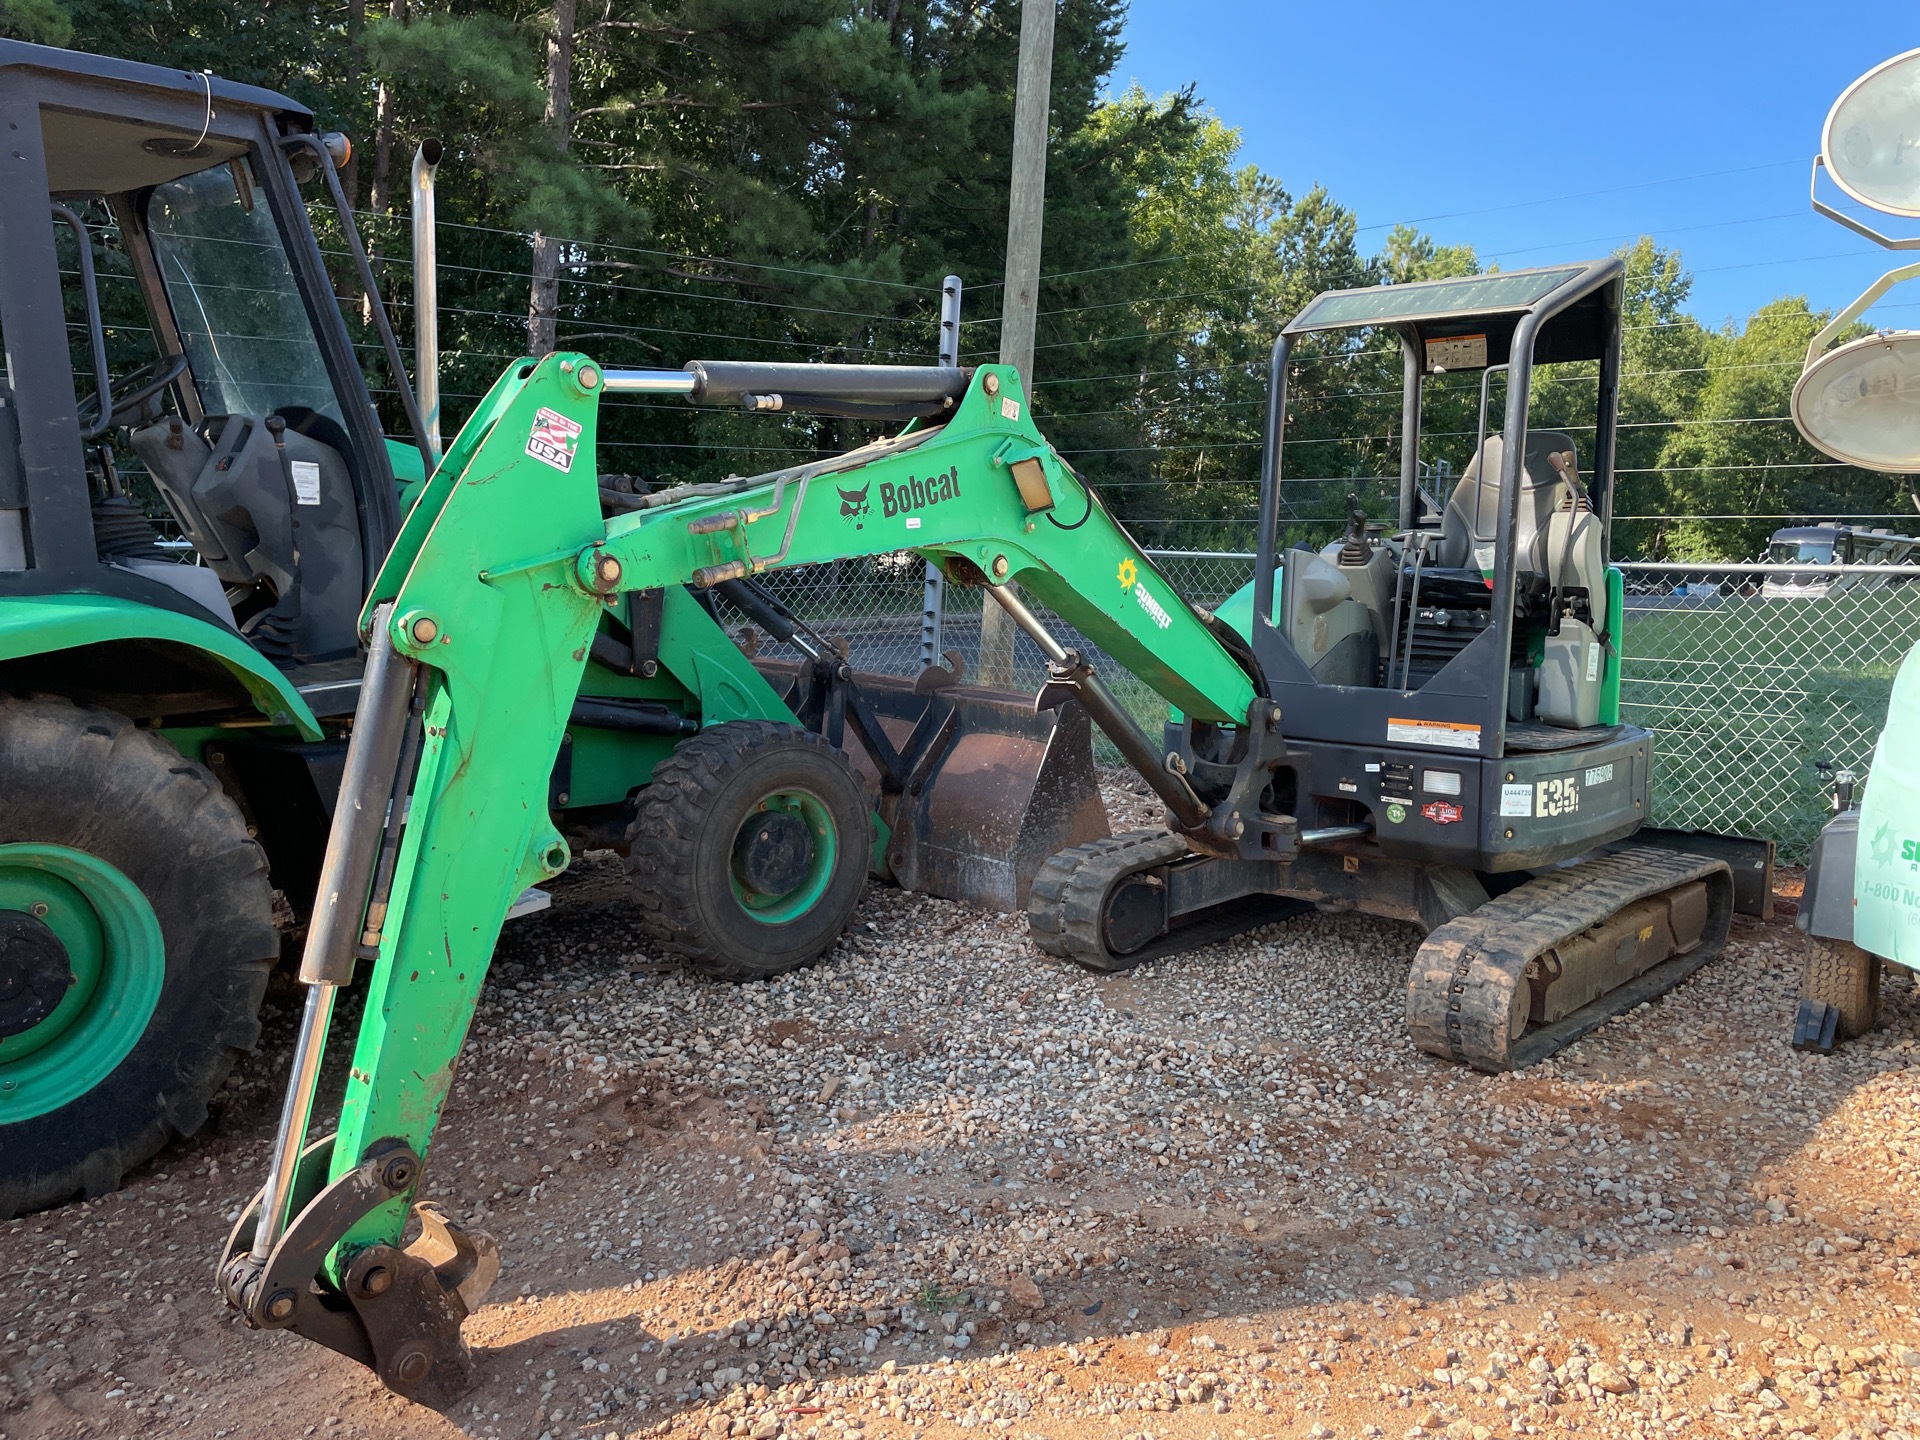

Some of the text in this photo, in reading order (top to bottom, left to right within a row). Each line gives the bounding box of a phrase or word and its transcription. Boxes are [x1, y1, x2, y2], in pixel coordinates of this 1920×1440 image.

[540, 408, 580, 432] MADE IN THE
[530, 439, 567, 466] USA
[880, 466, 961, 518] Bobcat
[1135, 582, 1172, 629] SUNBELT
[1137, 598, 1163, 629] RENTALS
[1423, 721, 1451, 729] WARNING
[1504, 789, 1532, 797] U444720
[1536, 777, 1580, 818] E35i
[1864, 880, 1900, 902] 1-800
